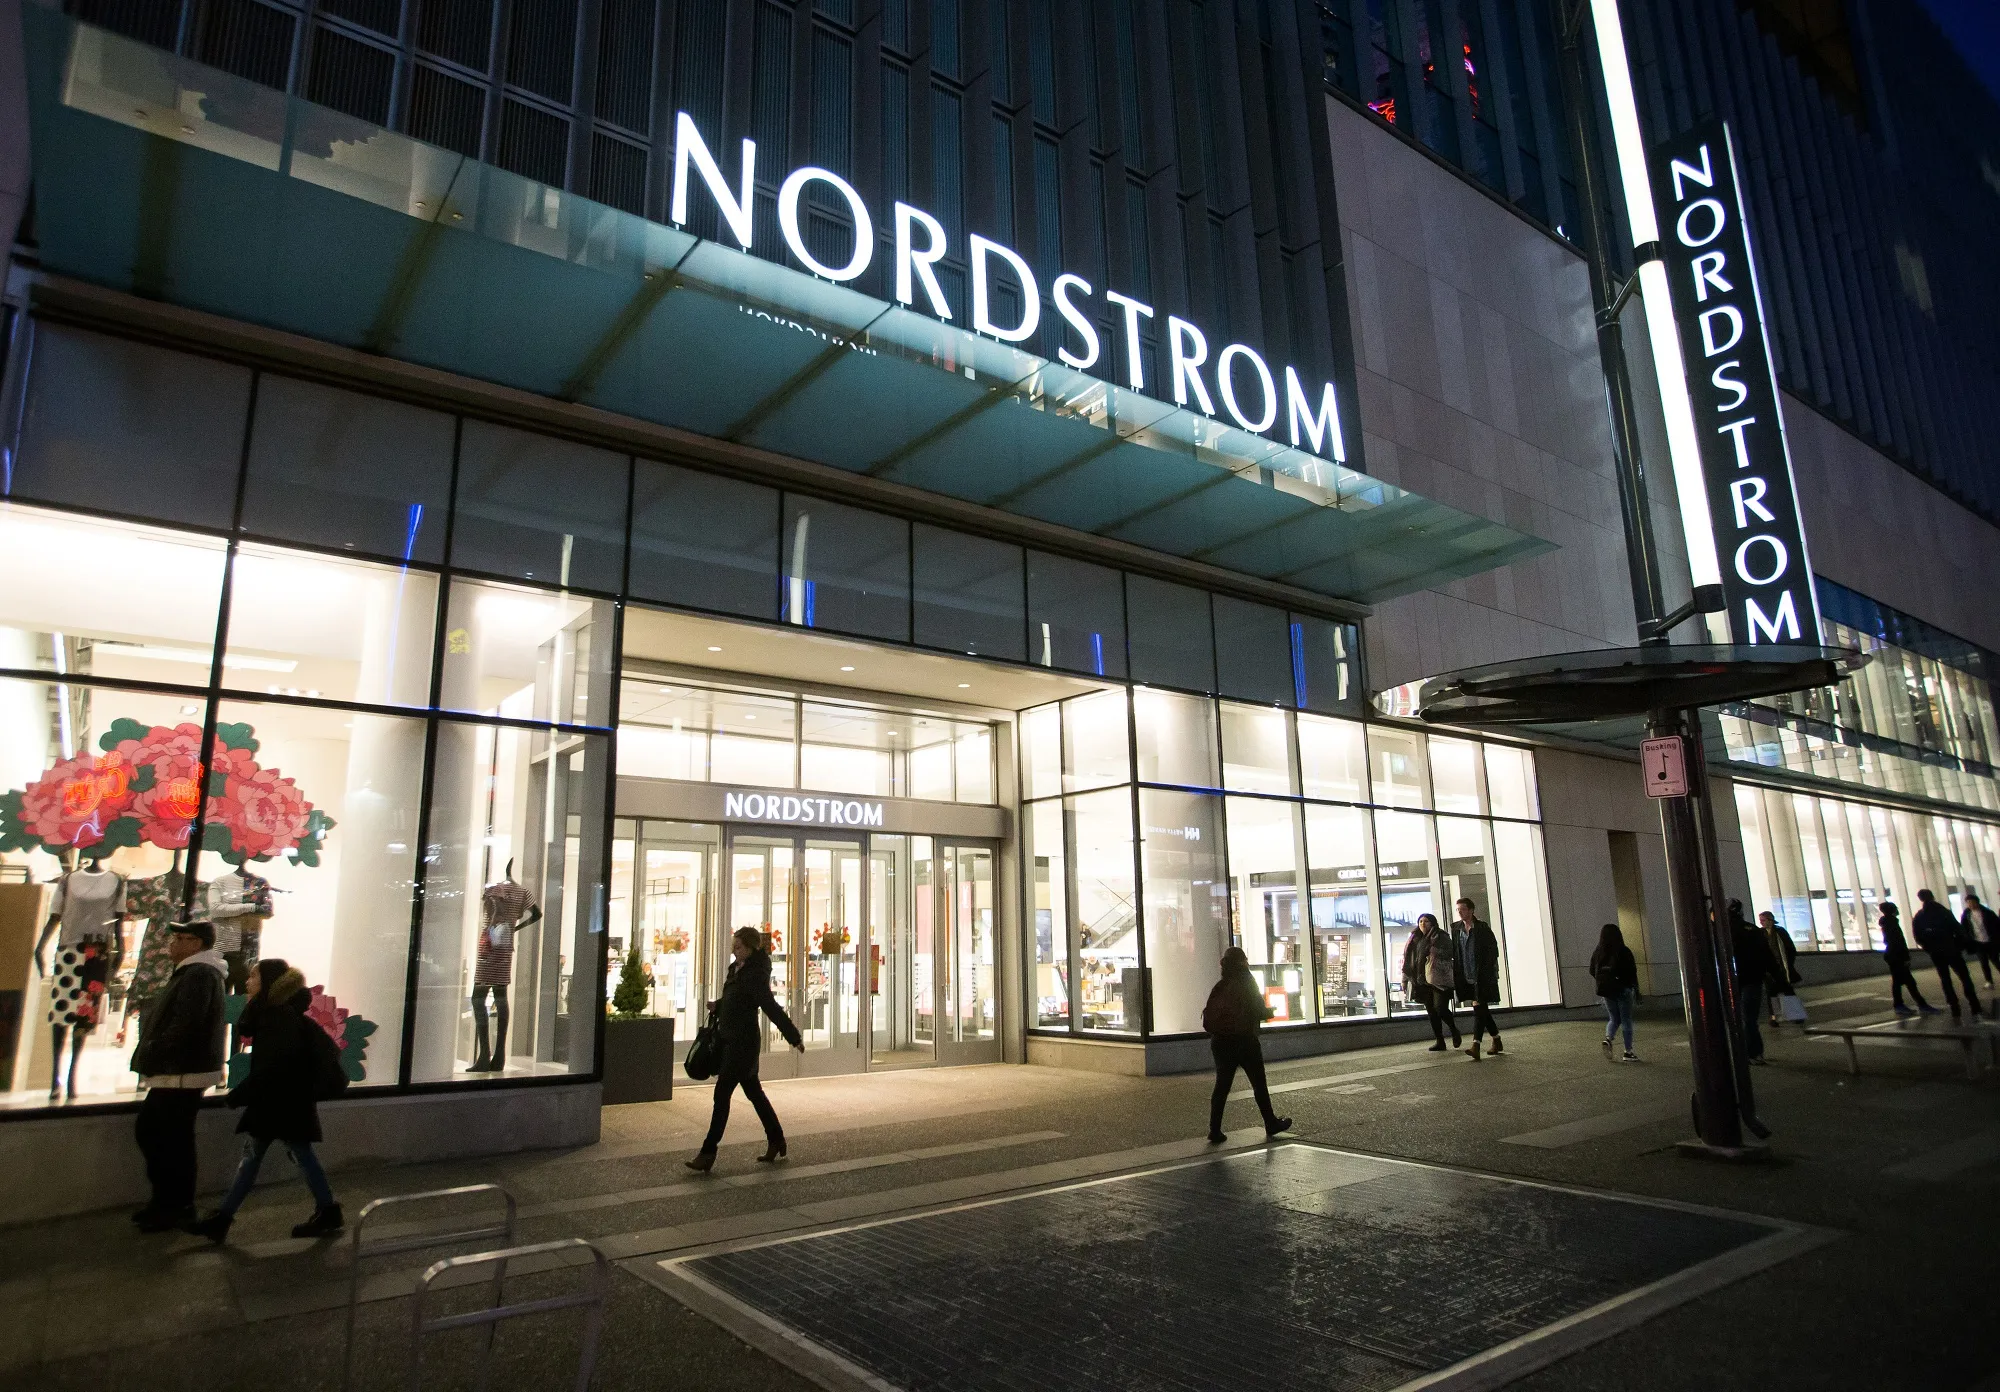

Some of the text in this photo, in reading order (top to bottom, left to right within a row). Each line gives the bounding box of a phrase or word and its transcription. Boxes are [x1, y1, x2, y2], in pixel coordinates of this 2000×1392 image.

[671, 112, 1346, 463] NORDSTROM
[1671, 145, 1802, 646] NORDSTROM
[725, 792, 883, 825] NORDSTROM
[1645, 742, 1677, 751] Busking
